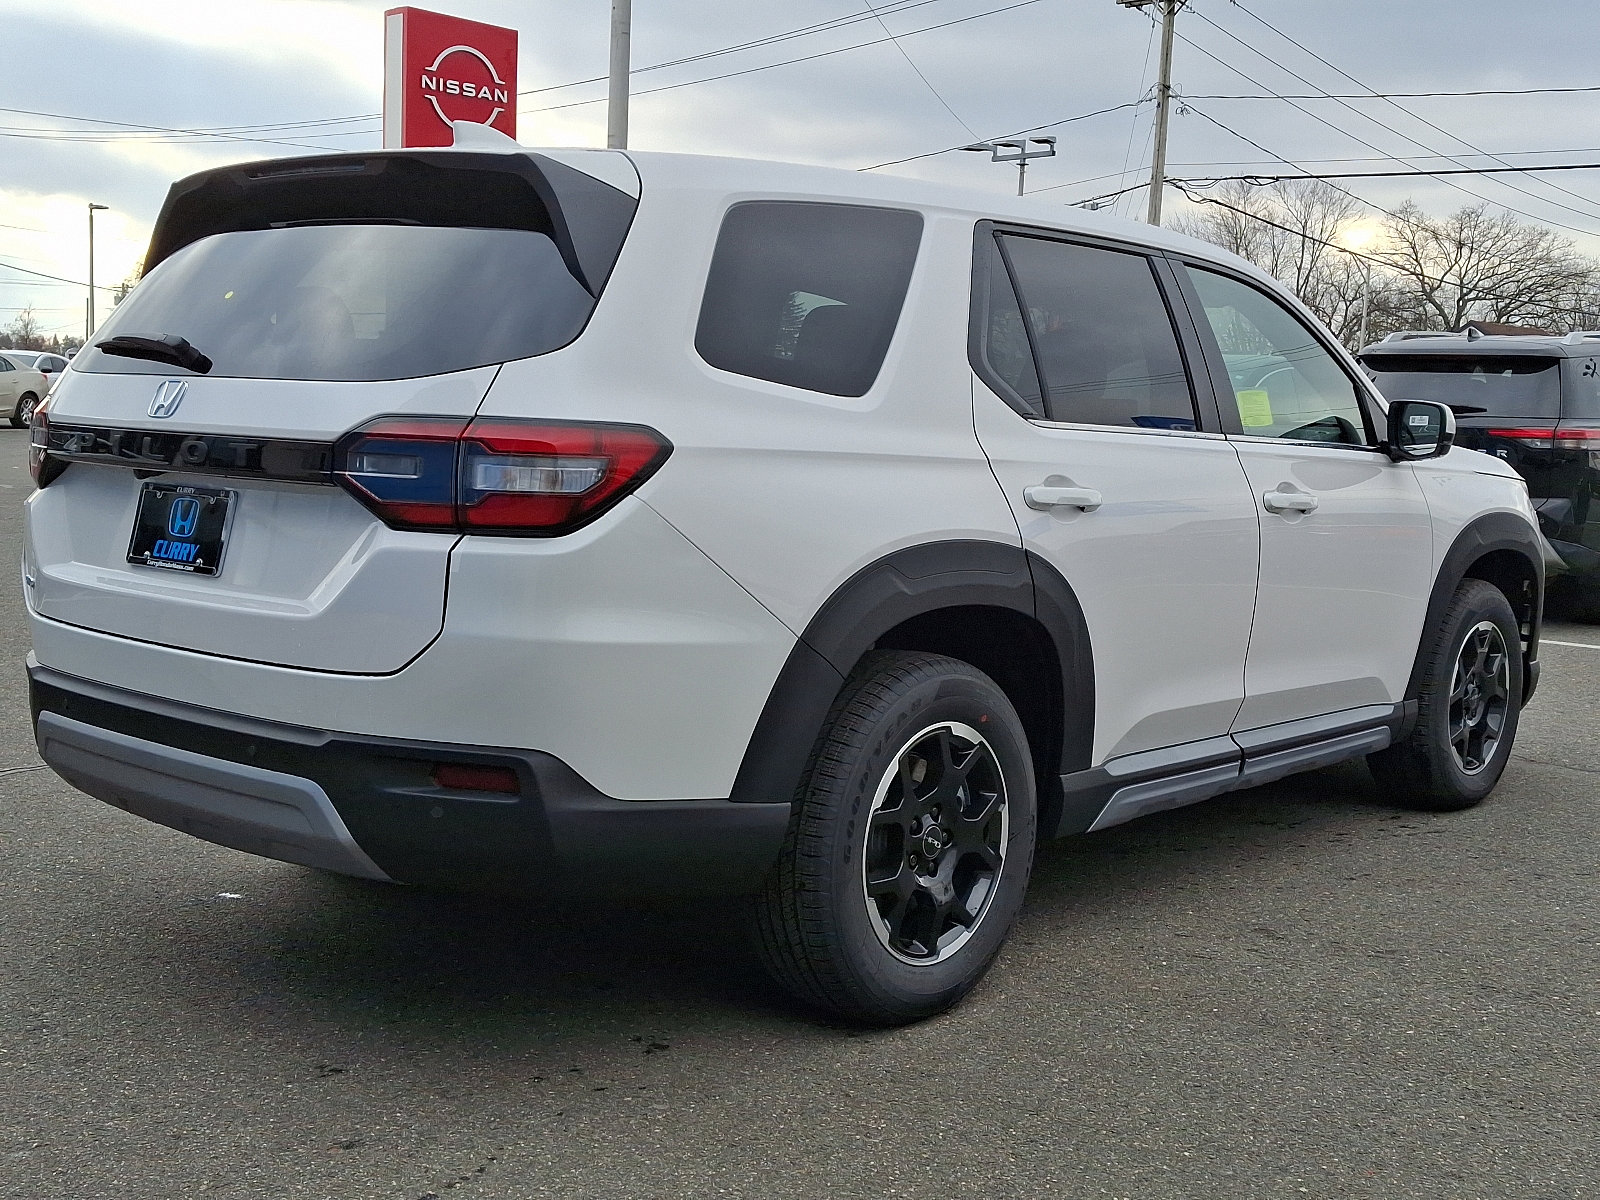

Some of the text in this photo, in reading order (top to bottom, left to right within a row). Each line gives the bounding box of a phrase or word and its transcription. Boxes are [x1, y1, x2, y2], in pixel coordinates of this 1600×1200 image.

[421, 74, 508, 104] NISSAN
[75, 432, 258, 467] PILOT
[176, 486, 196, 494] CURRY
[152, 539, 200, 562] CURRY
